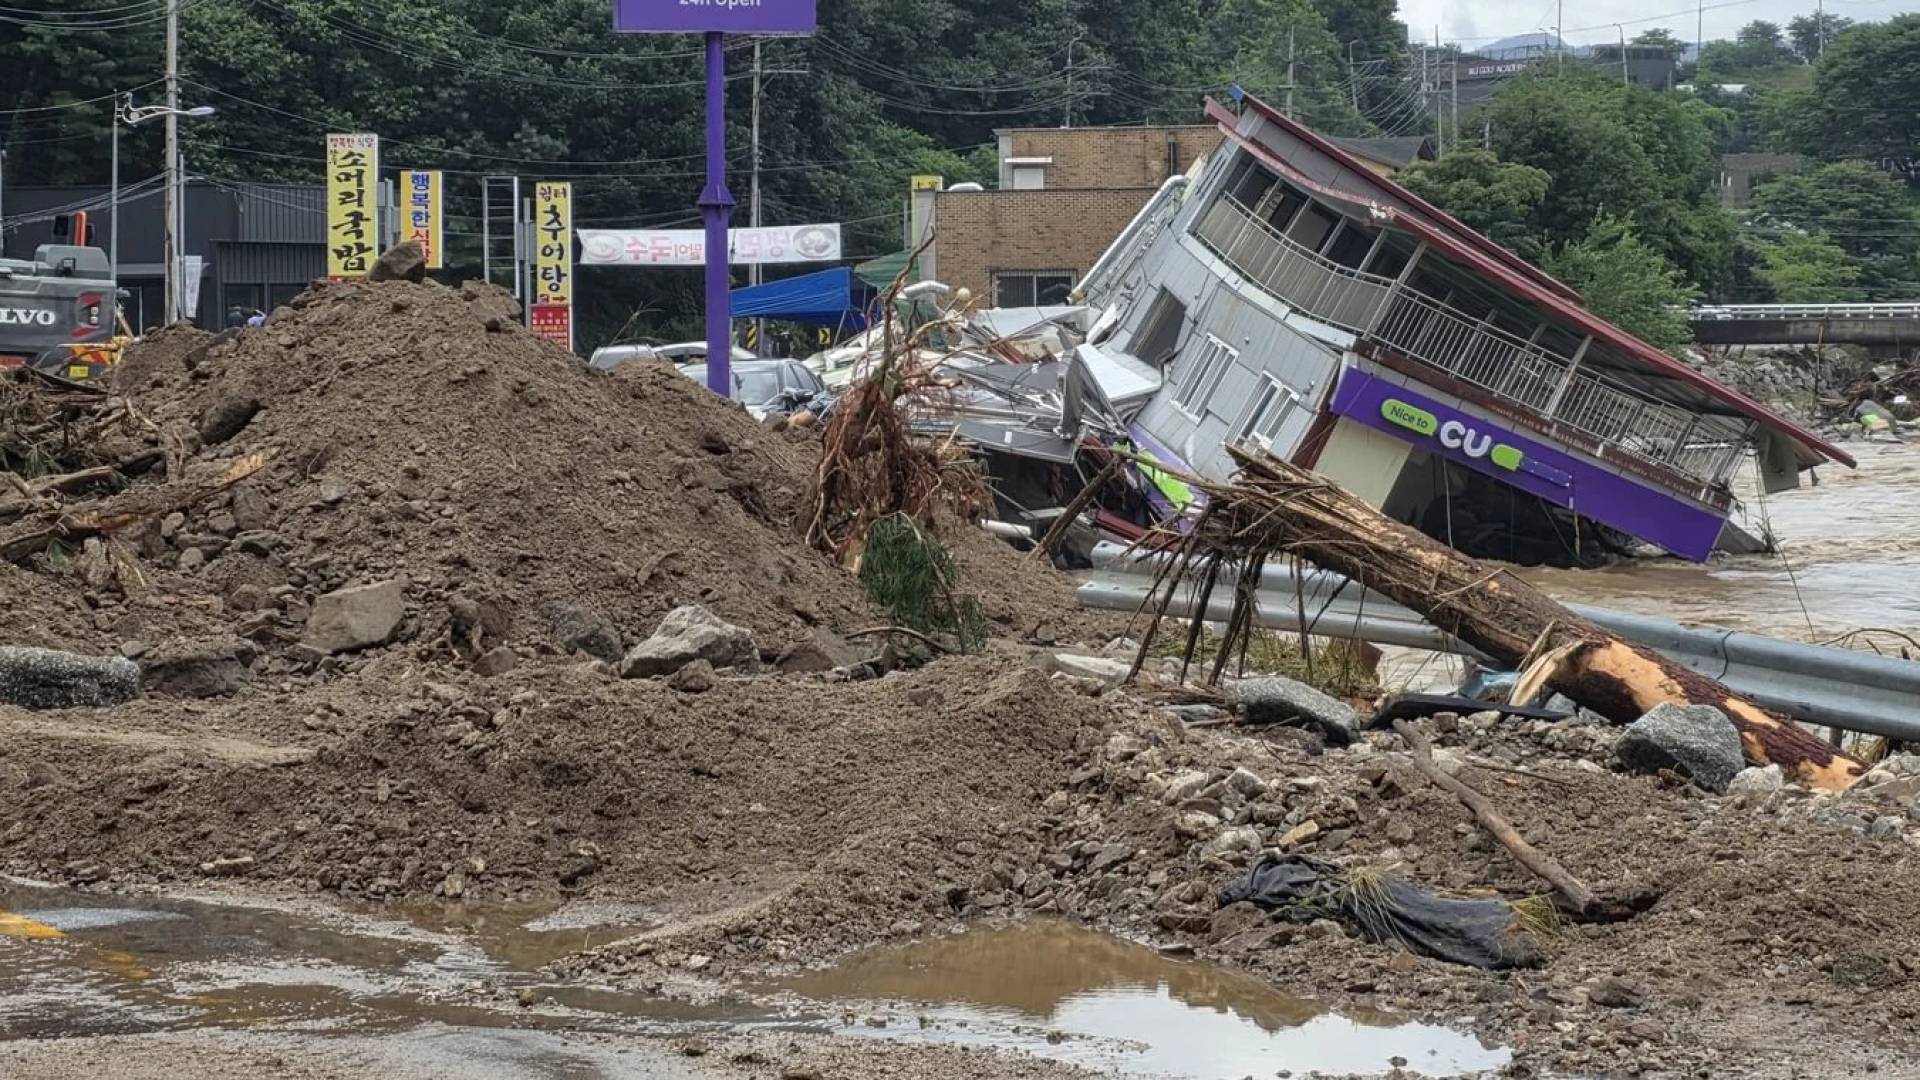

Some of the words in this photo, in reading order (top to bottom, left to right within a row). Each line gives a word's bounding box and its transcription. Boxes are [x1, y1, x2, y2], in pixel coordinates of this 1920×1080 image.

[331, 150, 373, 271] 소머리국밥
[541, 204, 567, 292] 추어탕
[1391, 406, 1415, 424] Nice
[1417, 418, 1428, 429] to
[1440, 420, 1492, 458] CU
